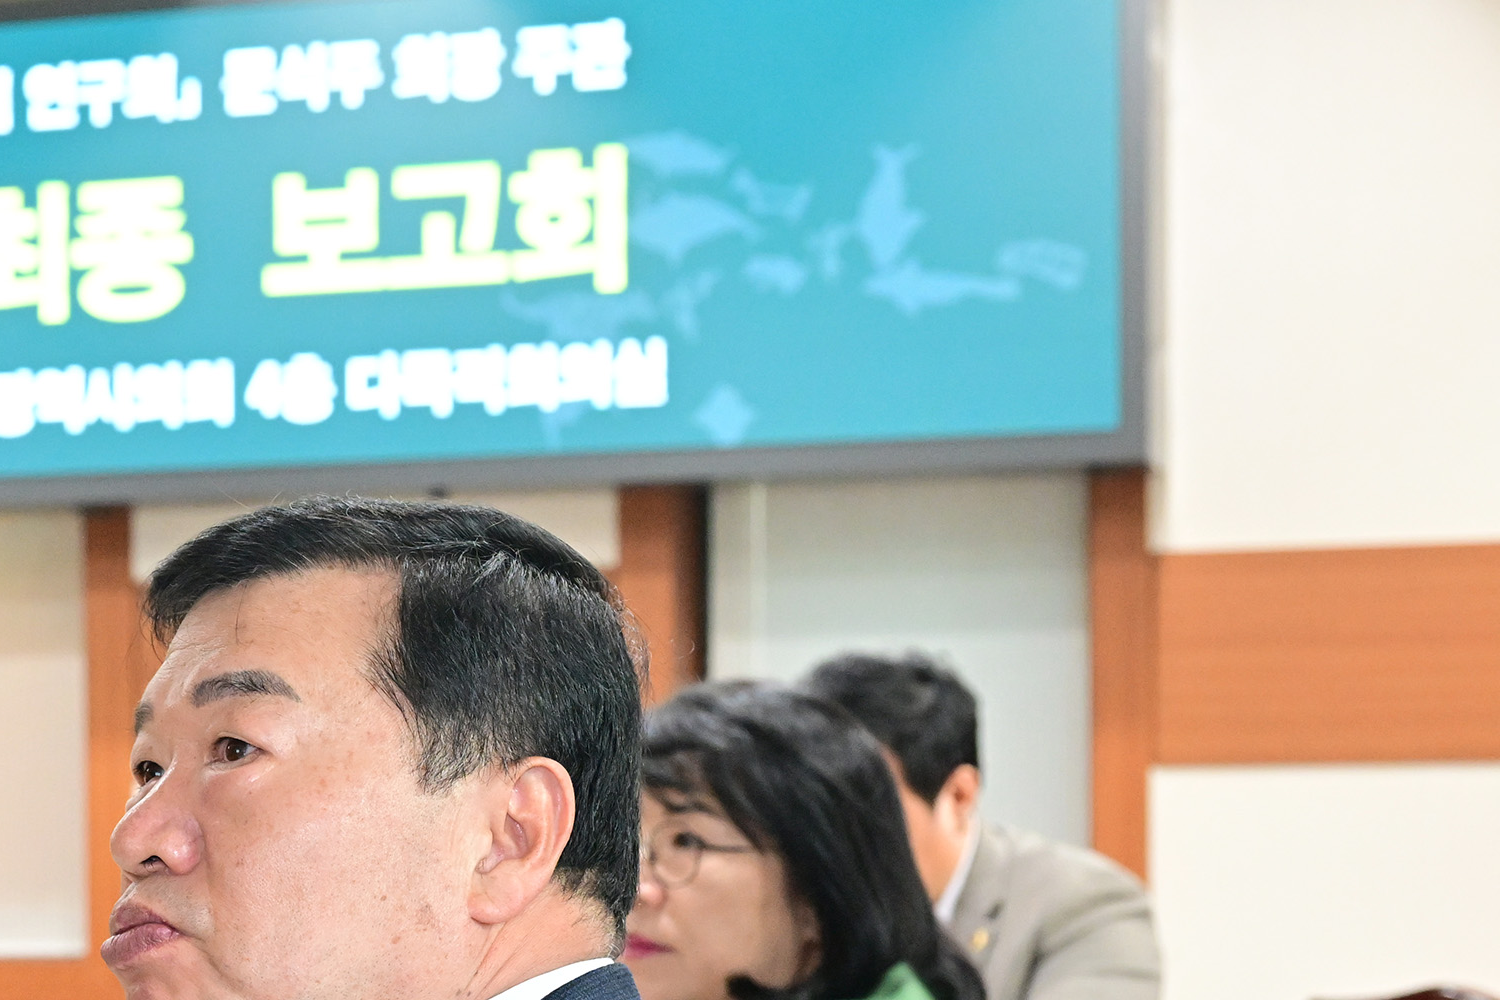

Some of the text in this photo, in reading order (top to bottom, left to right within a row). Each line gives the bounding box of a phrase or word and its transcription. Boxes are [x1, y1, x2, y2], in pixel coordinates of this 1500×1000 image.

[513, 19, 629, 95] 주관
[262, 144, 627, 296] 보고회
[246, 354, 336, 423] 4층
[346, 338, 667, 418] 다목적회의실
